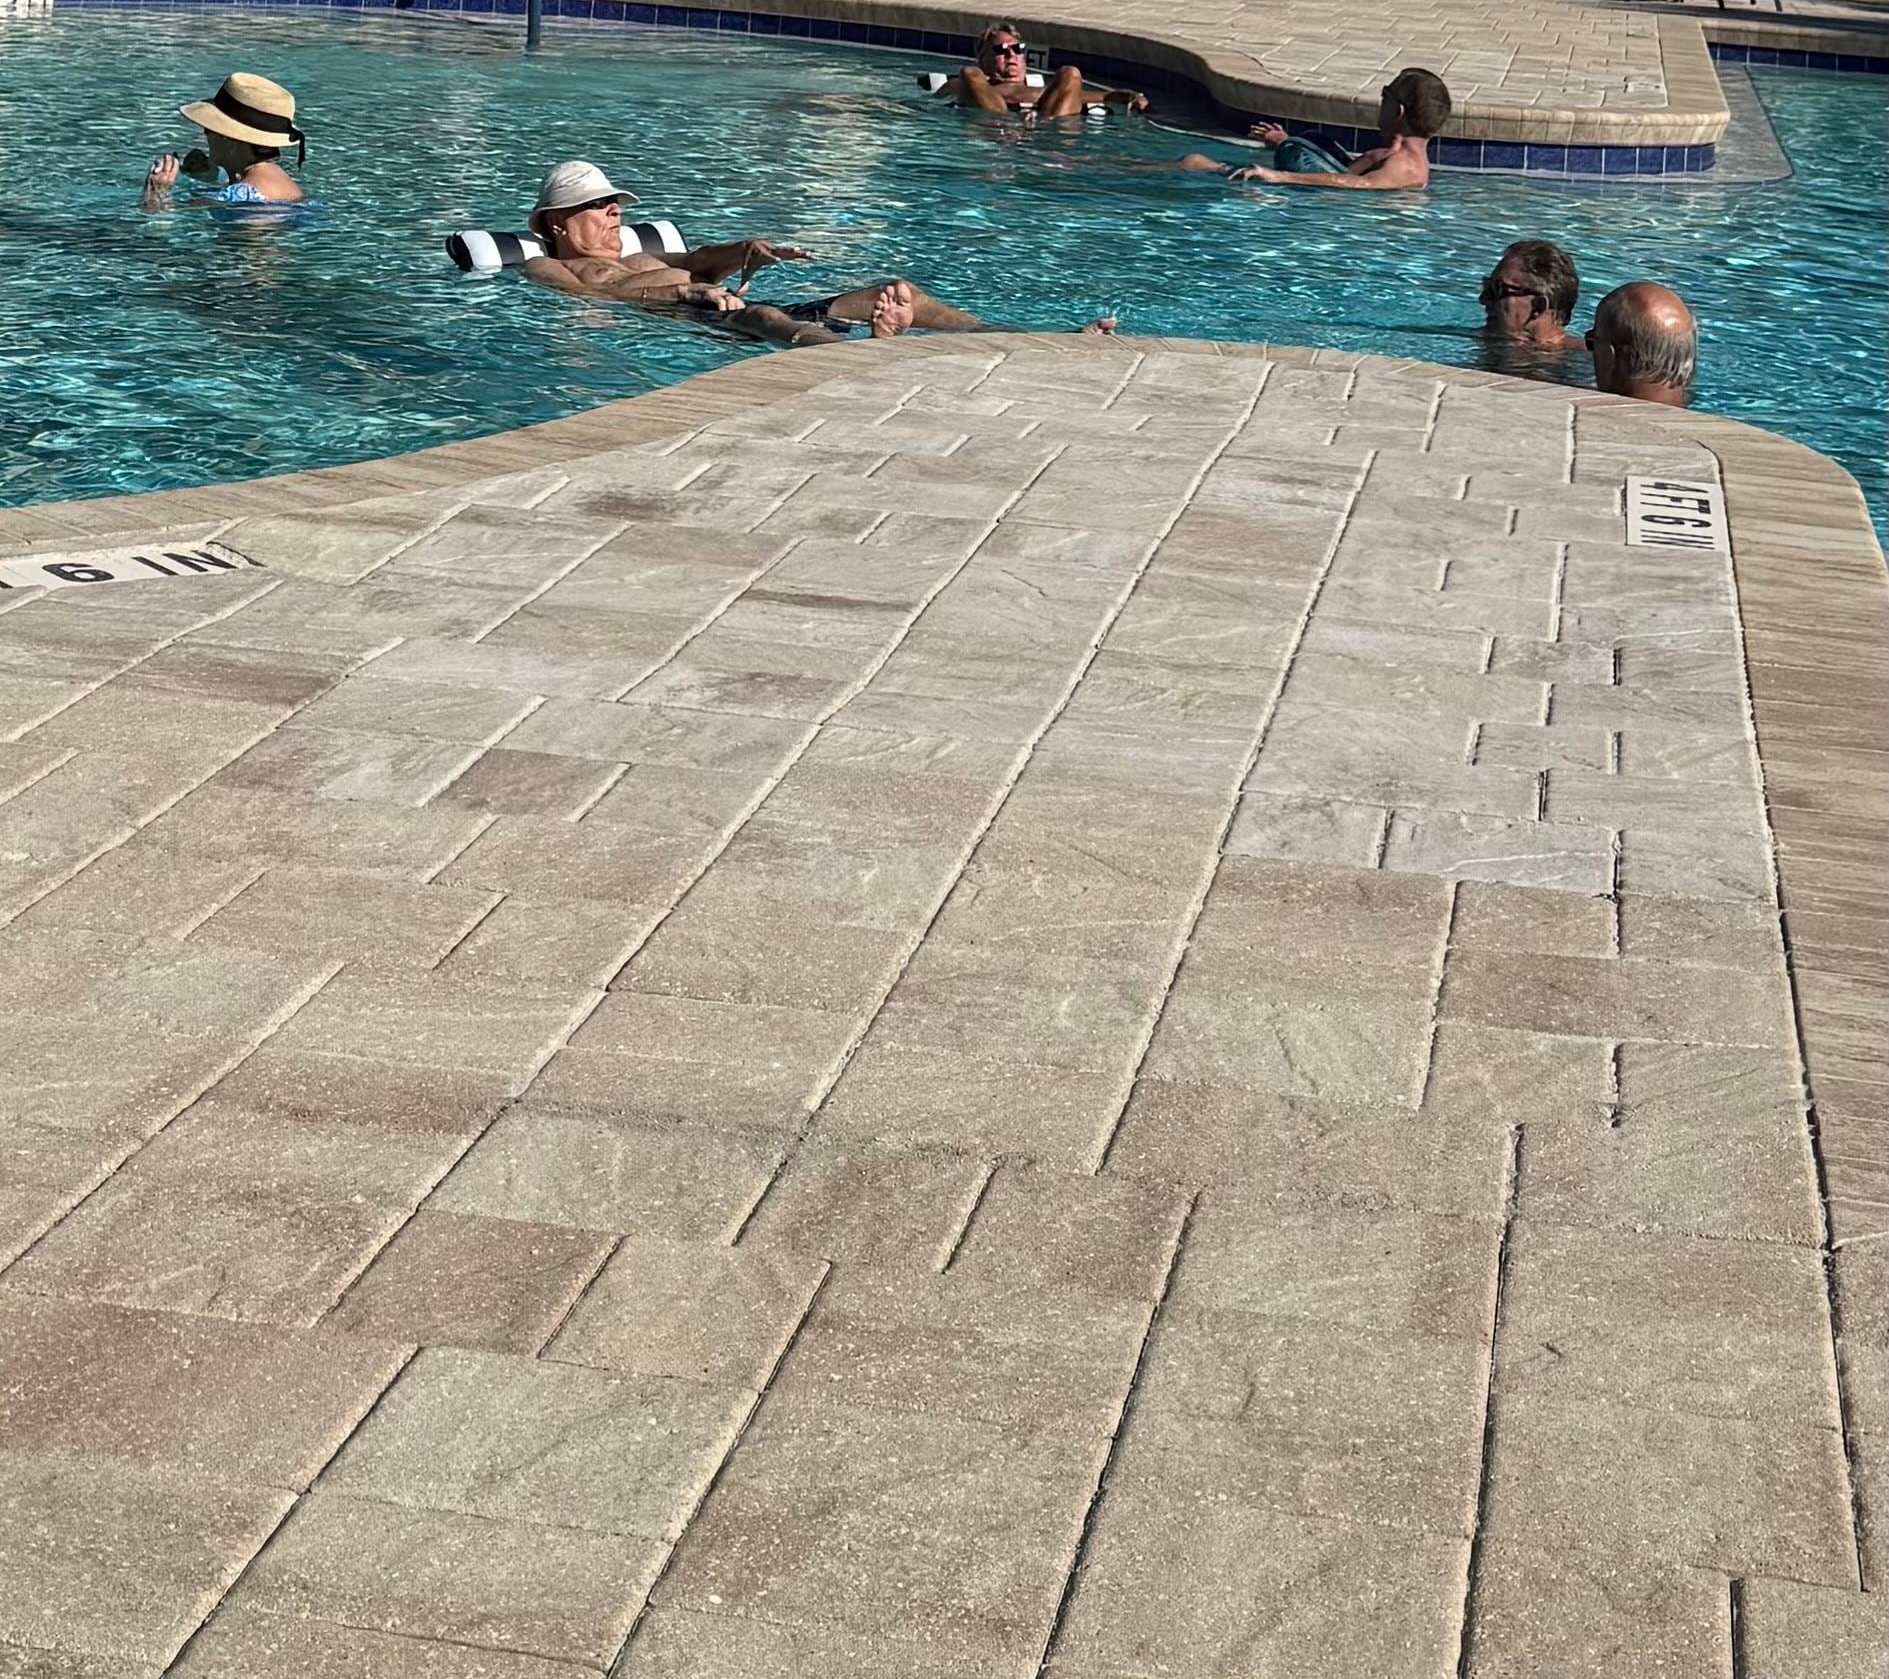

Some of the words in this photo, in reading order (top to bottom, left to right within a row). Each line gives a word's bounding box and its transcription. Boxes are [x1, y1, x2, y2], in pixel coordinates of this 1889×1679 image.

[1641, 514, 1712, 528] 6
[1640, 529, 1716, 550] IN
[42, 562, 115, 583] 6
[131, 549, 239, 577] IN
